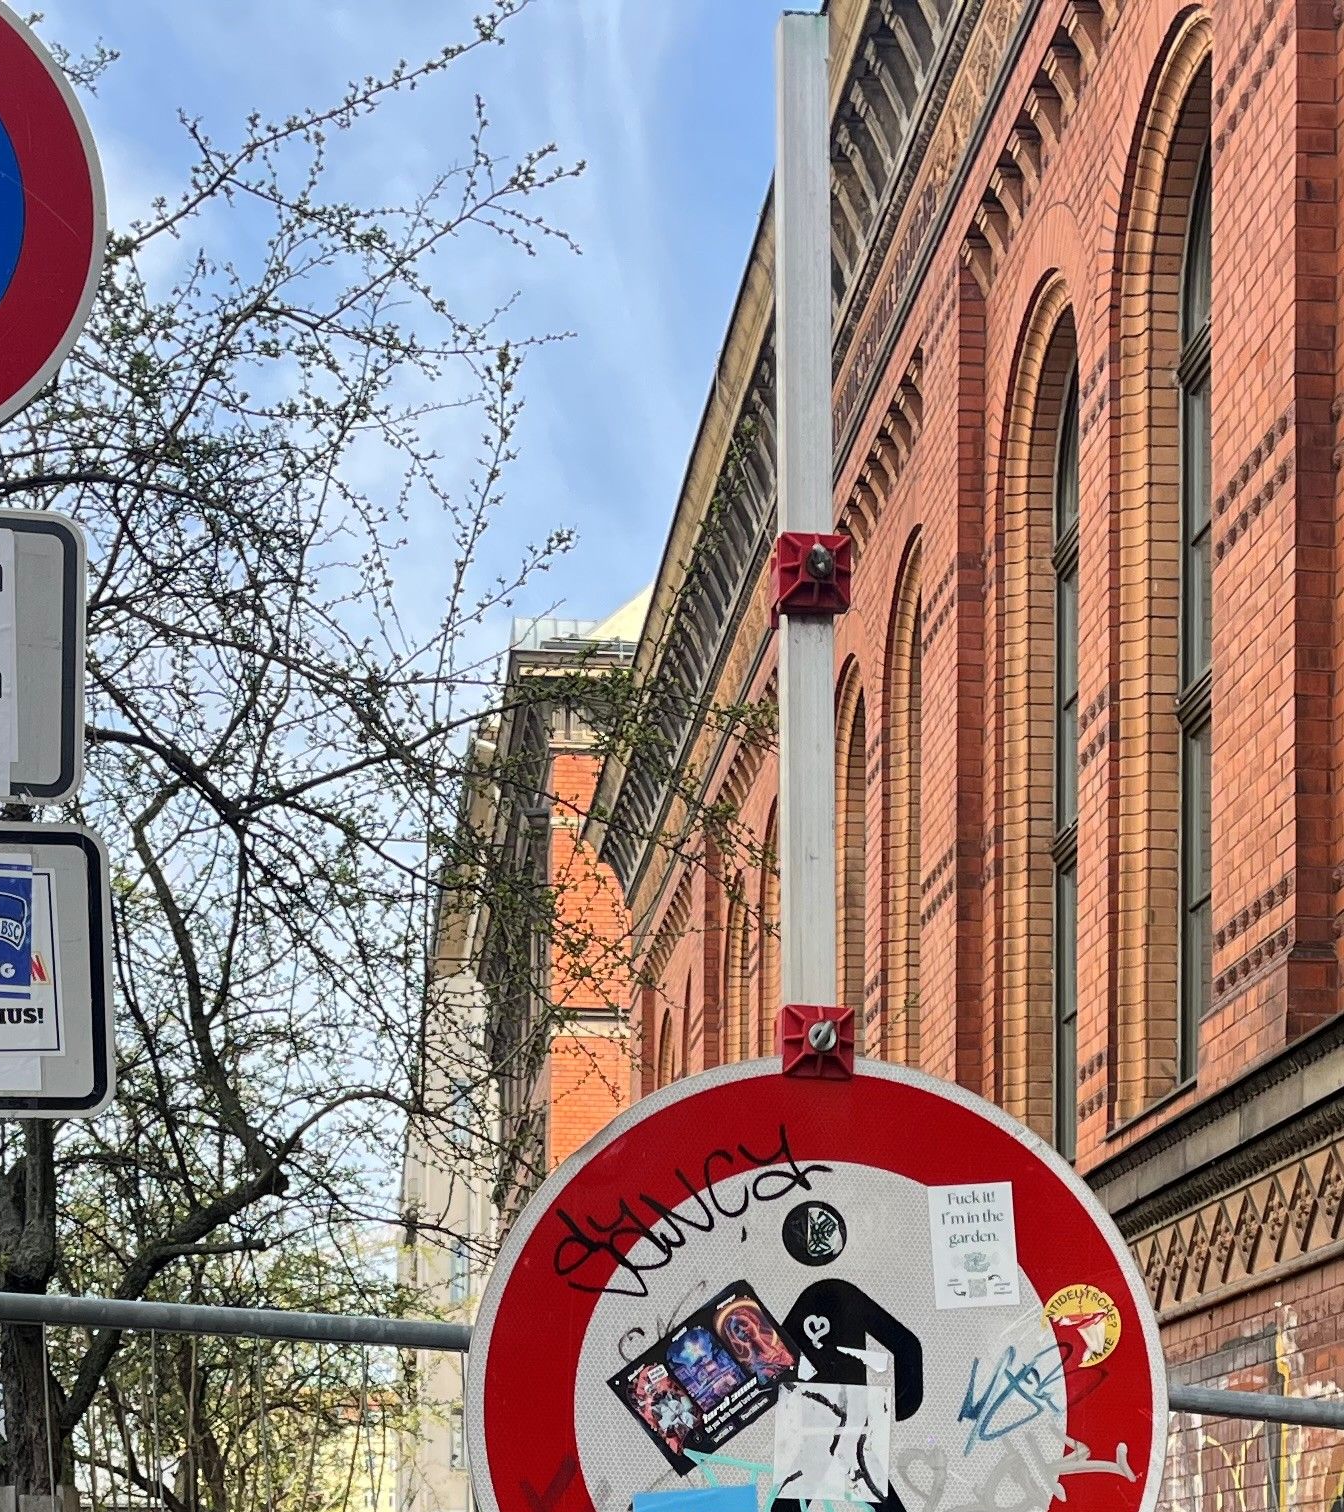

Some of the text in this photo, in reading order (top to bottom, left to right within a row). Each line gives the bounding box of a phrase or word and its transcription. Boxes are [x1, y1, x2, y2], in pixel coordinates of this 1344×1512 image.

[947, 1189, 981, 1206] Fuck
[967, 1211, 980, 1224] in
[982, 1208, 1005, 1223] the
[948, 1229, 1000, 1249] garden.
